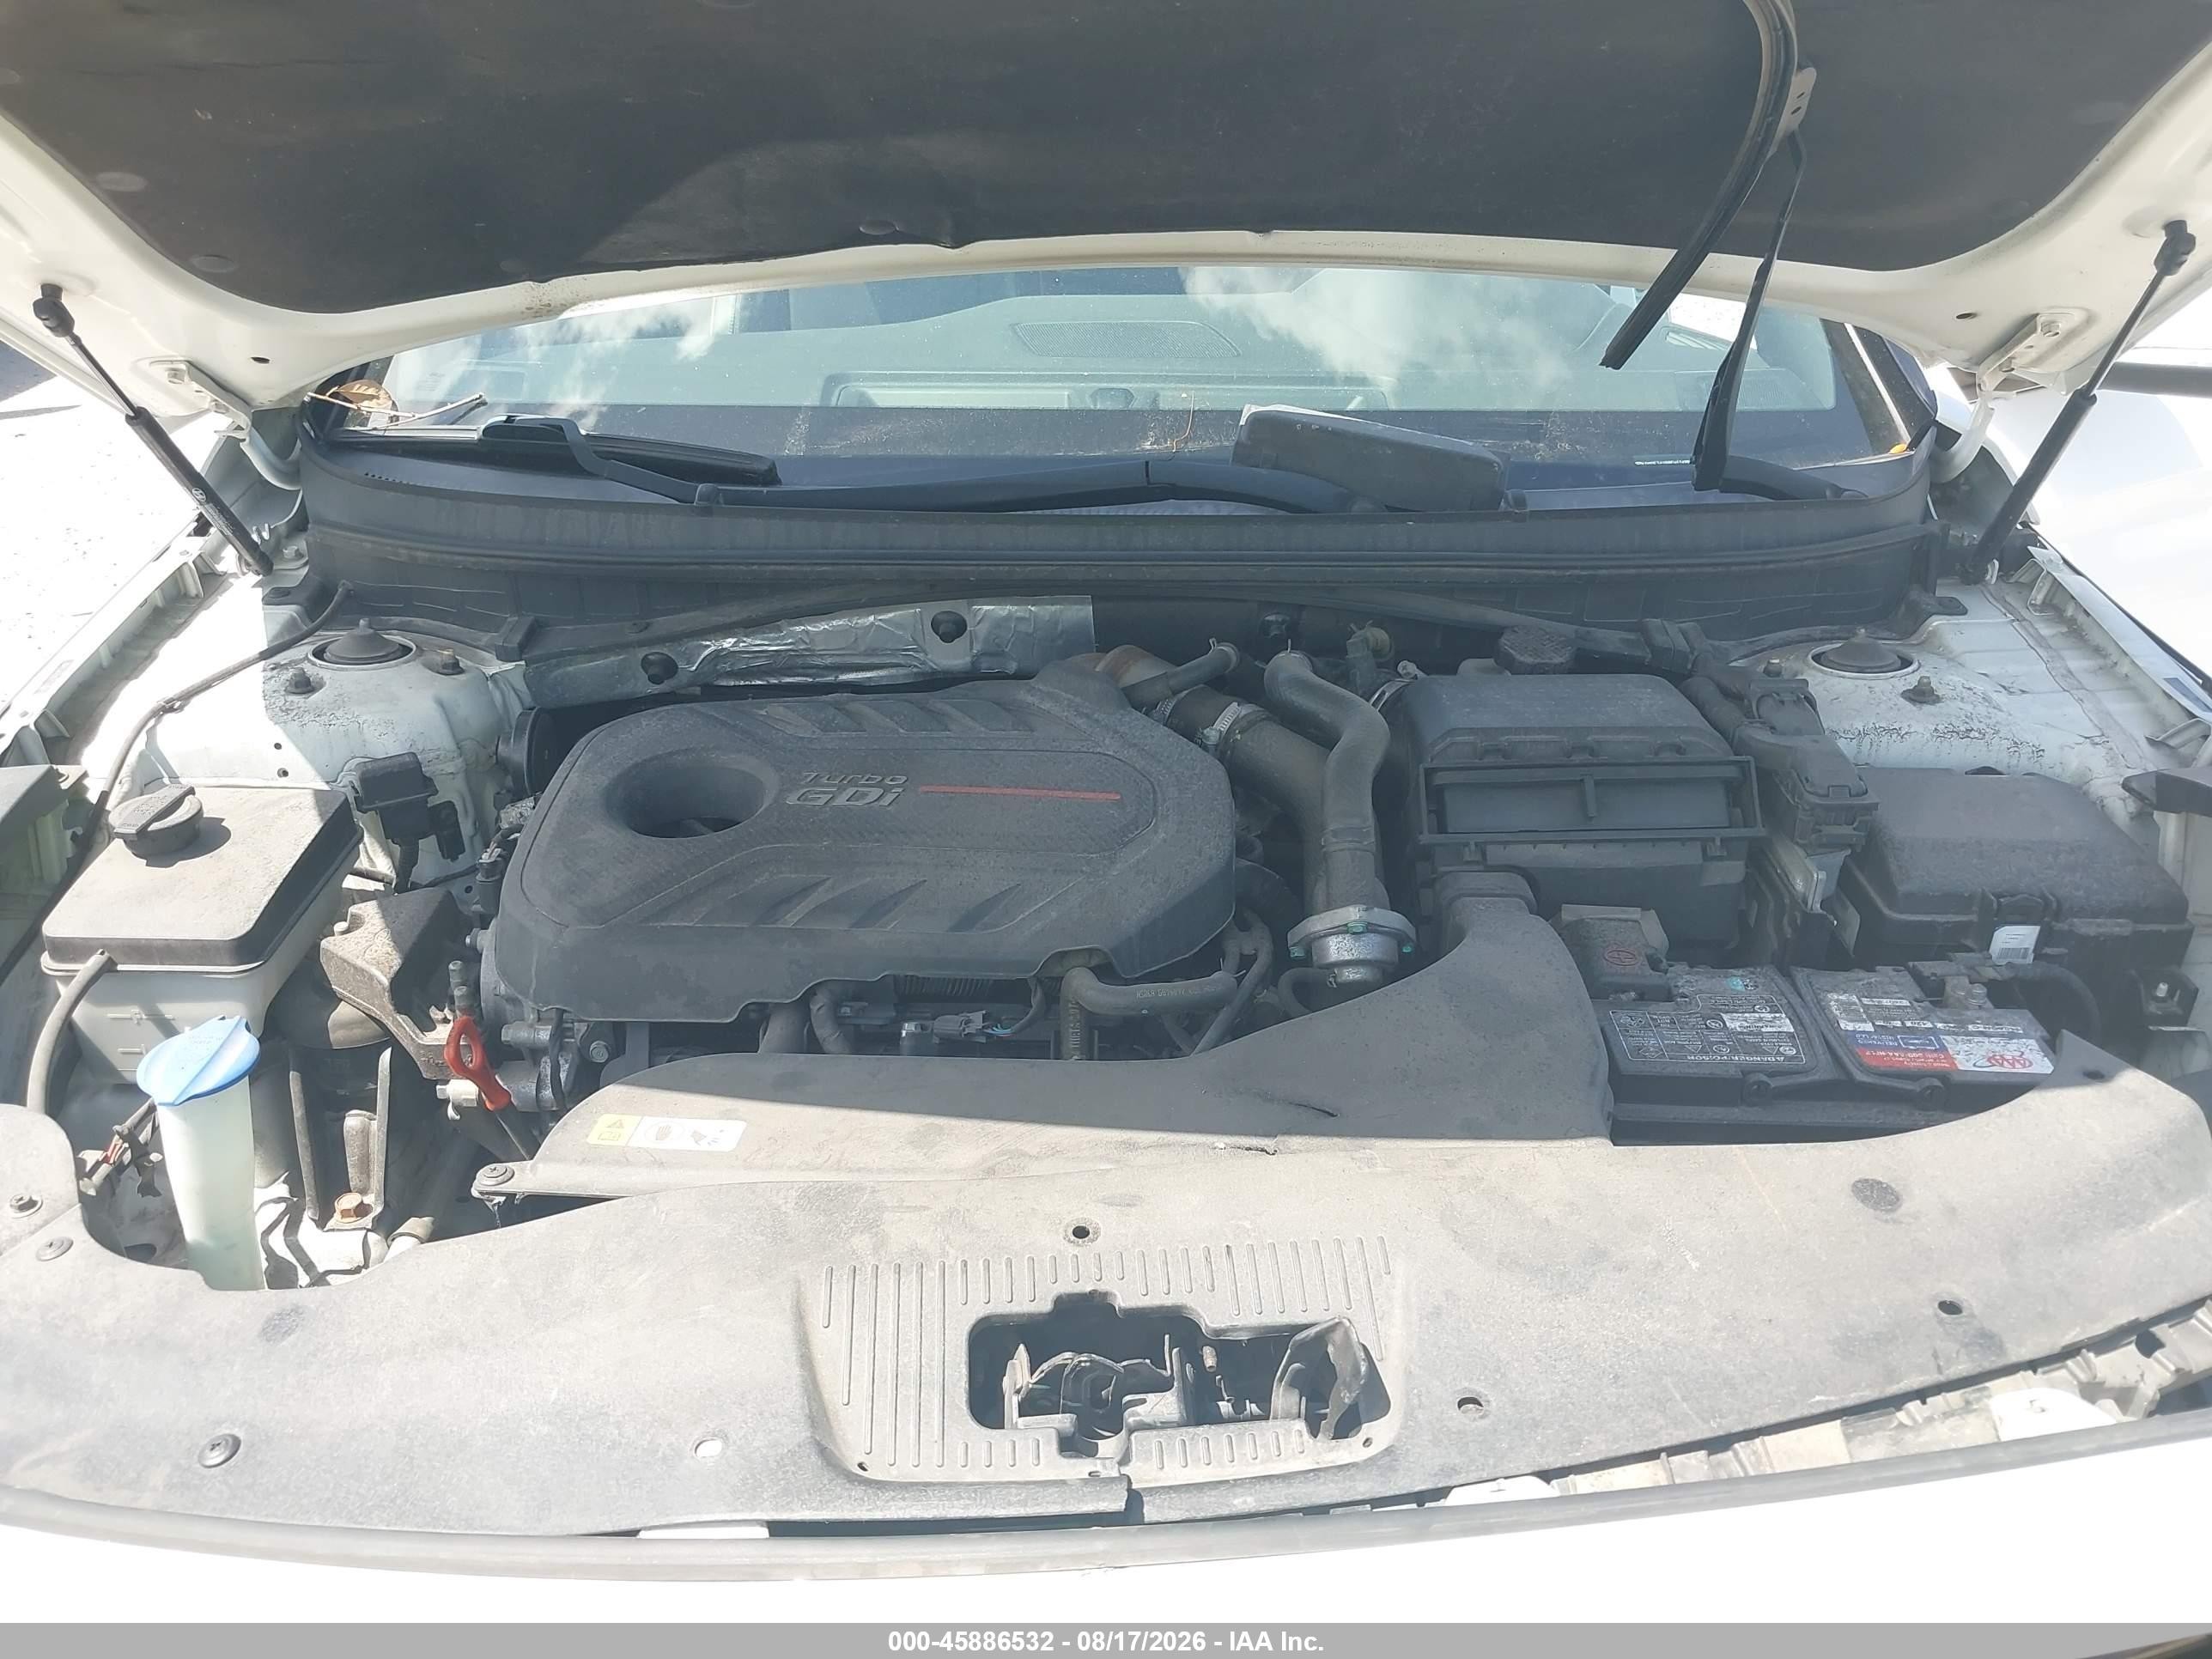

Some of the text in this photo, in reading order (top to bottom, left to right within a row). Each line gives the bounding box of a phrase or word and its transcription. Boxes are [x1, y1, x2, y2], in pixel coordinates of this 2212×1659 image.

[802, 772, 908, 785] Turbo
[789, 787, 907, 806] GDi
[1991, 1055, 2027, 1068] AAA
